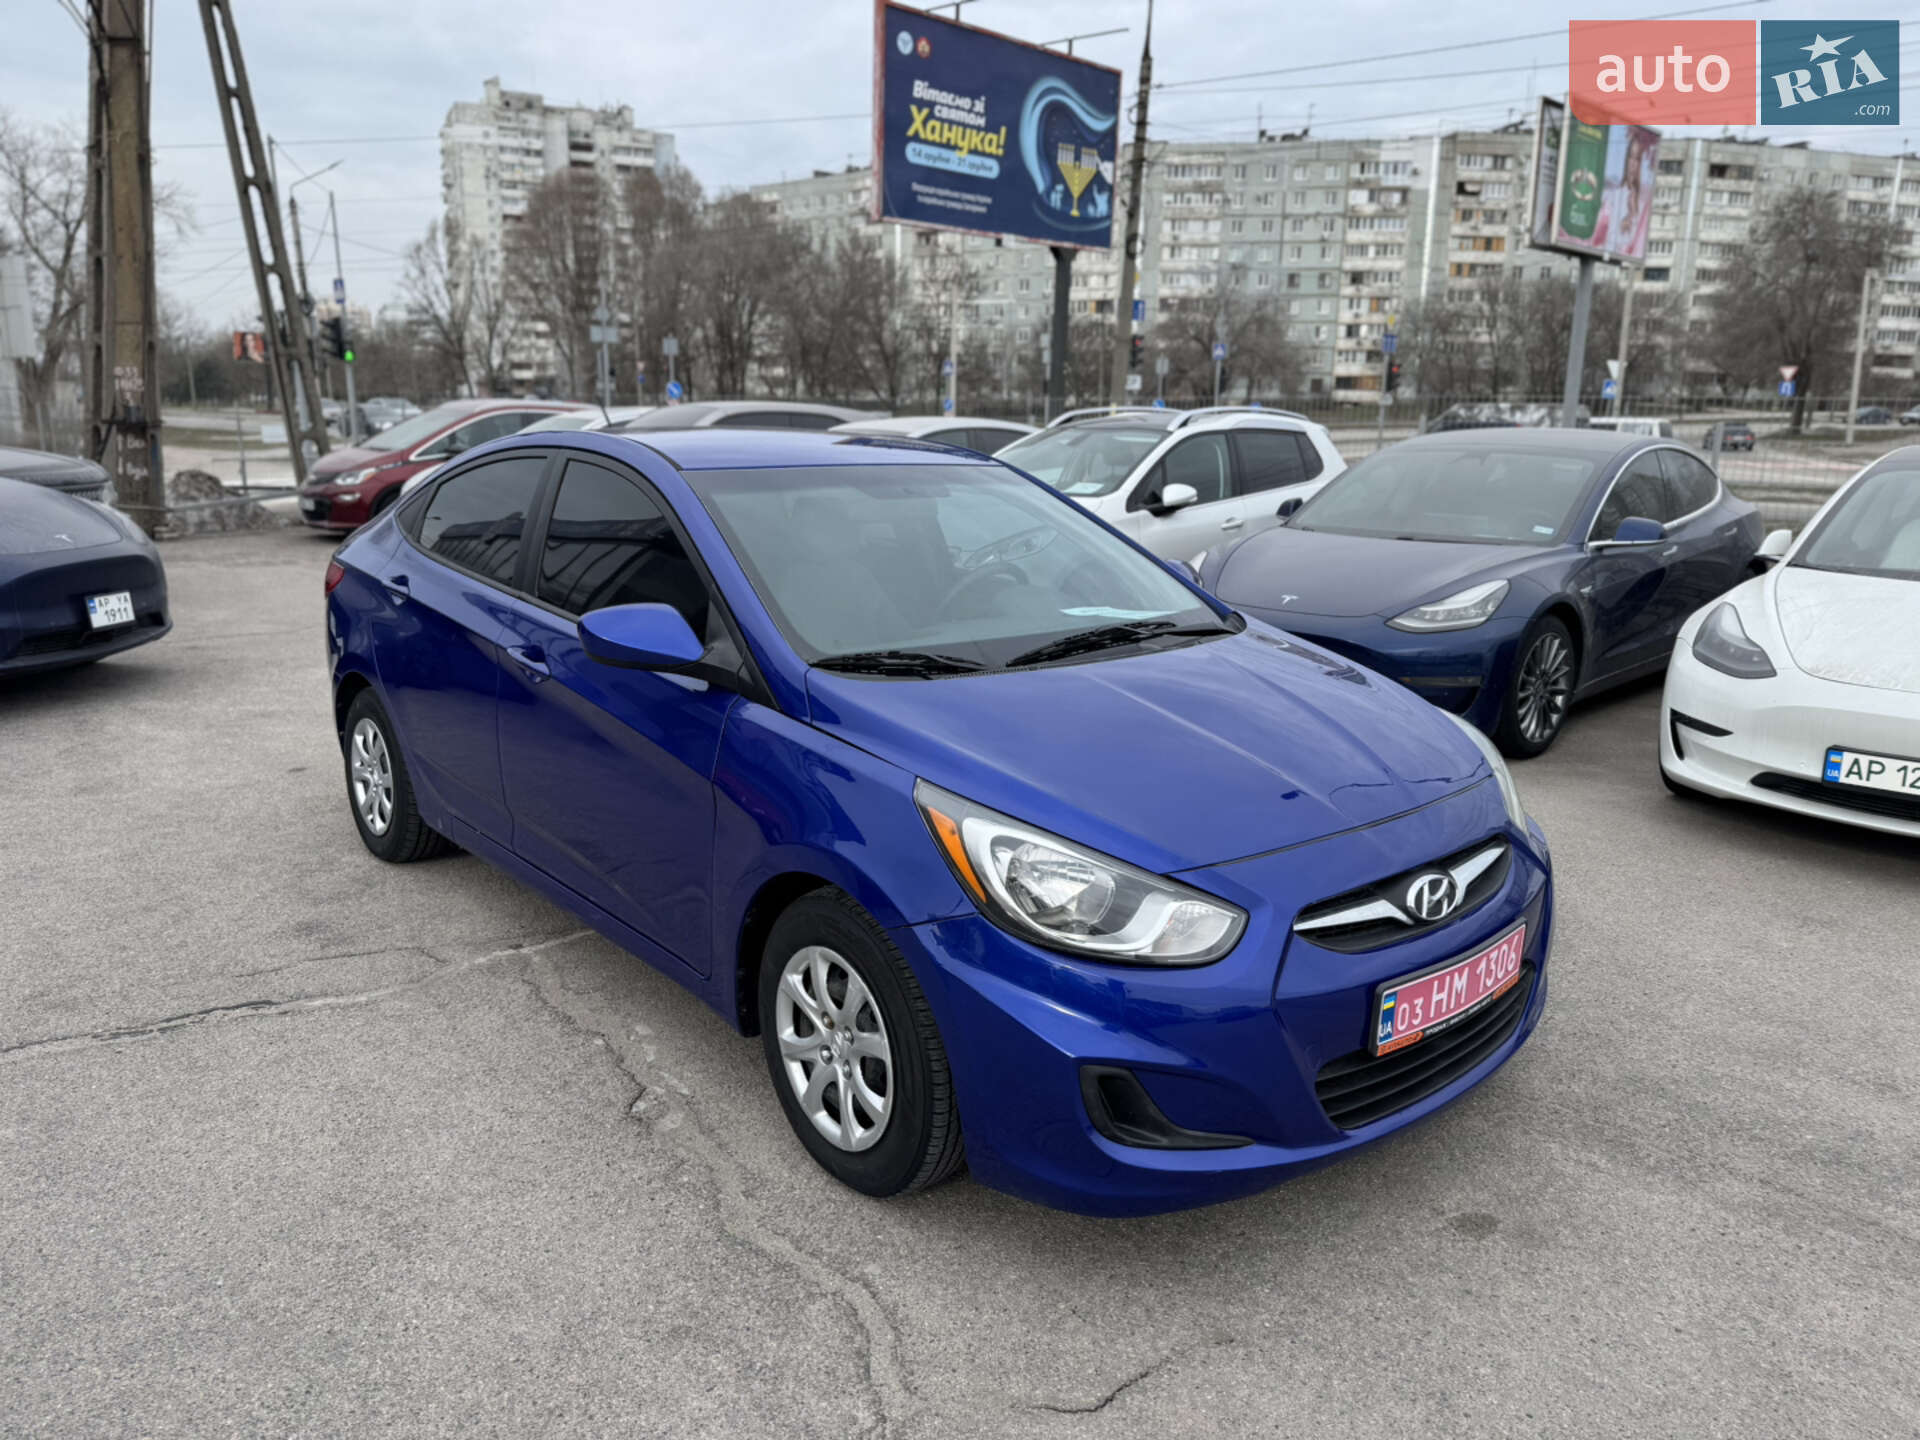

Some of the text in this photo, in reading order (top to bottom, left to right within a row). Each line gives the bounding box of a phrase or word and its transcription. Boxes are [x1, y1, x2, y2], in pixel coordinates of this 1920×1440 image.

[912, 80, 972, 110] Вітаємо
[934, 104, 986, 127] святом
[906, 104, 1007, 156] Ханука!
[104, 606, 129, 622] 1911
[1844, 757, 1886, 782] AP
[1396, 996, 1425, 1032] 03
[1429, 966, 1470, 1019] HM
[1475, 934, 1520, 994] 1306
[1379, 1020, 1393, 1038] UA
